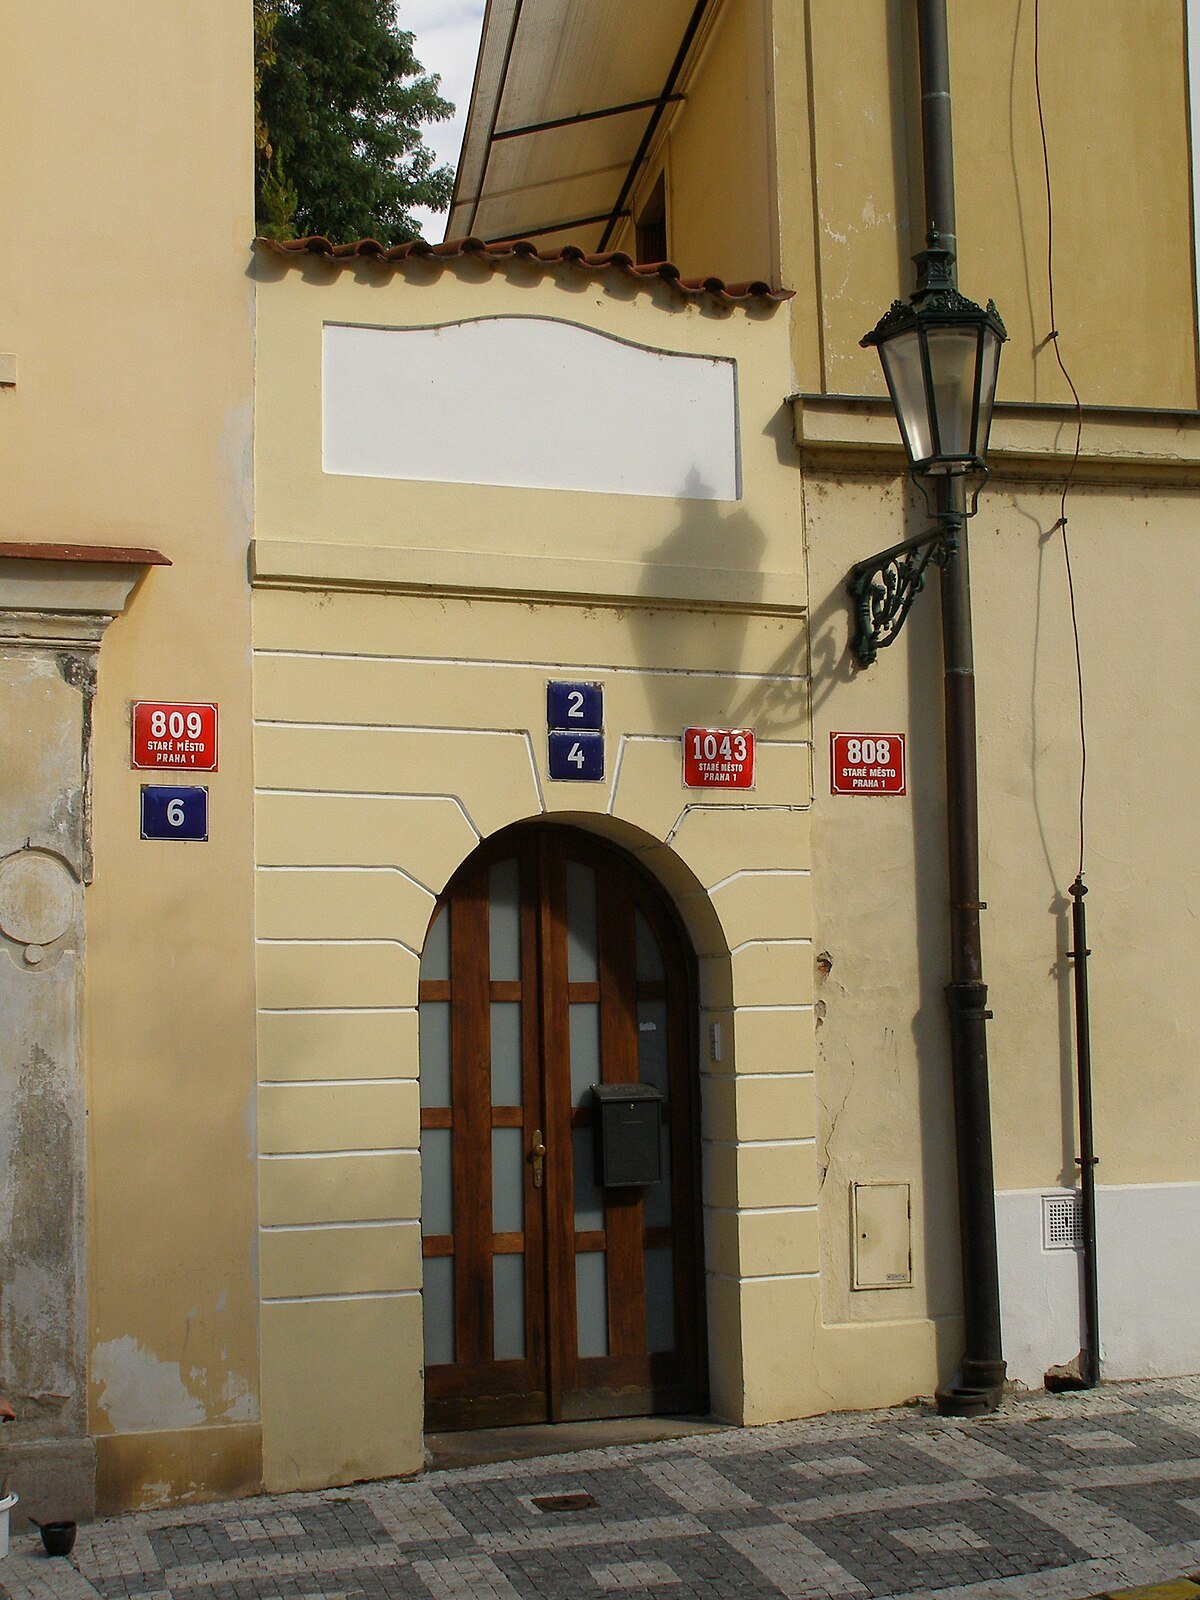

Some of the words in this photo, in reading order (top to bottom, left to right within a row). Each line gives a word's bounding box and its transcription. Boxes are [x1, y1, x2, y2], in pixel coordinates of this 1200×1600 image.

[567, 691, 584, 718] 2
[151, 710, 202, 739] 809
[147, 739, 173, 751] STARÉ
[176, 740, 205, 752] MĚSTO
[693, 735, 747, 761] 1043
[847, 739, 890, 764] 808
[156, 753, 186, 763] PRAHA
[190, 754, 195, 763] 1
[567, 742, 585, 769] 4
[698, 762, 720, 771] STARÉ
[720, 762, 743, 772] MĚSTO
[842, 766, 867, 777] STARÉ
[869, 767, 896, 778] MĚSTO
[703, 772, 730, 781] PRAHA
[733, 773, 737, 782] 1
[852, 779, 879, 788] PRAHA
[881, 780, 886, 788] 1
[166, 798, 185, 827] 6
